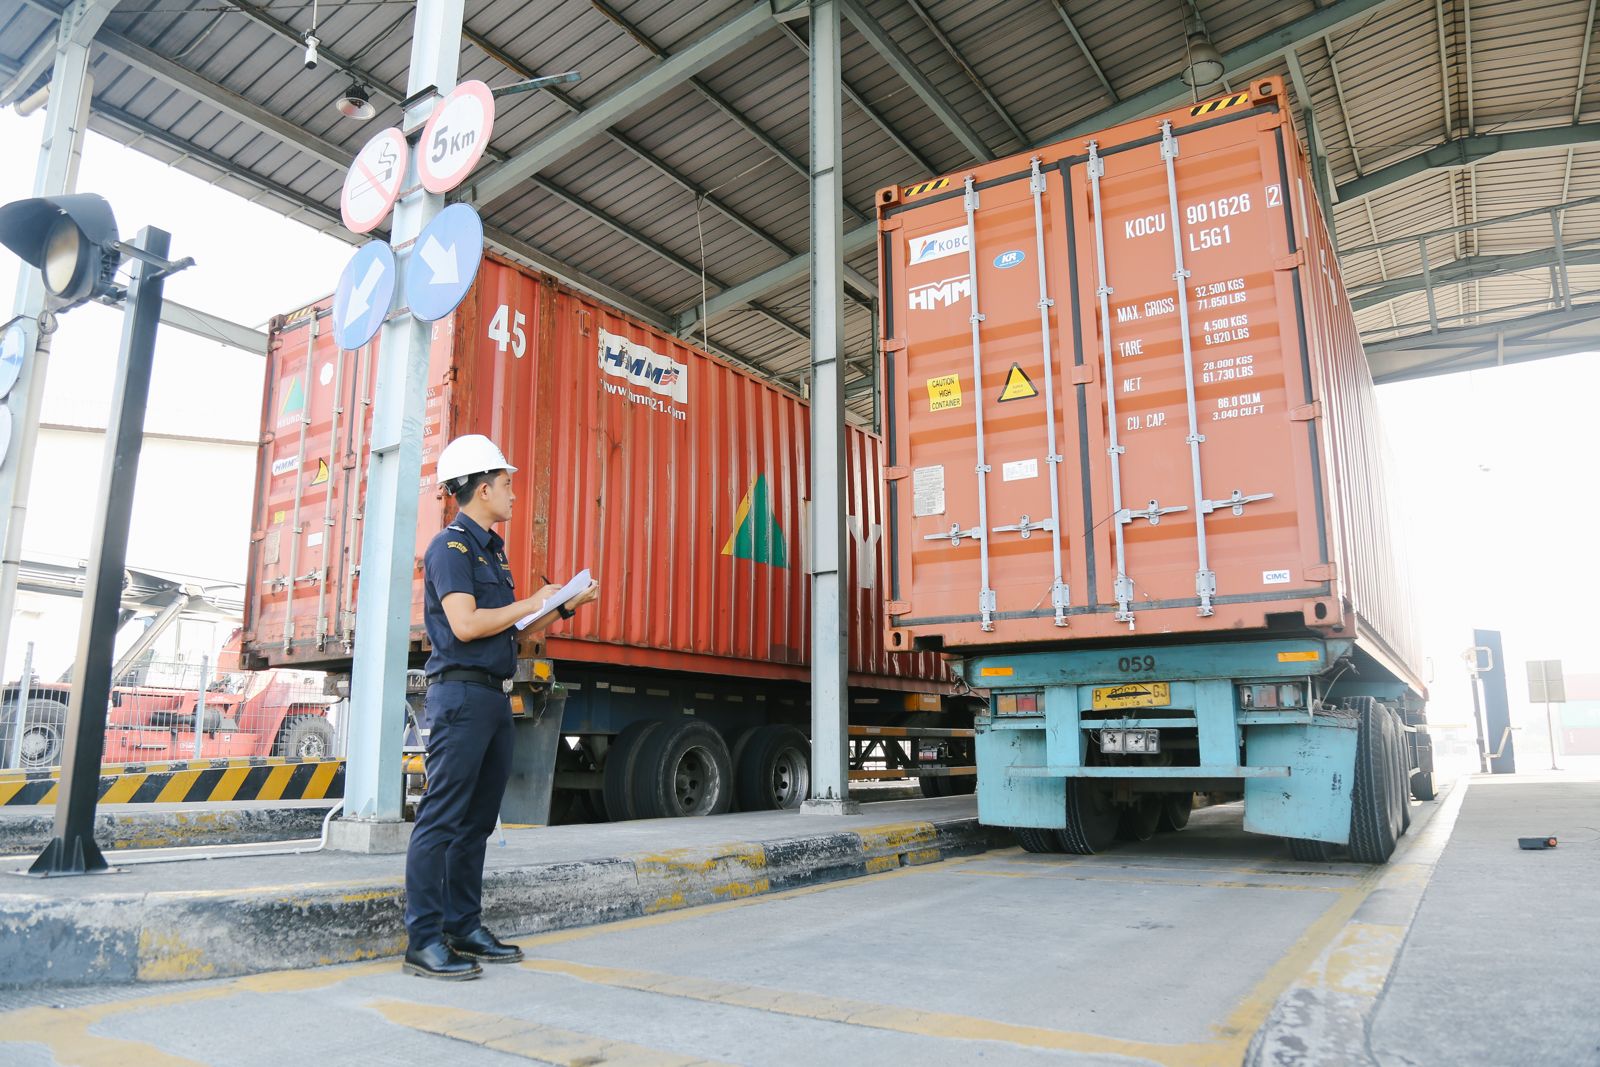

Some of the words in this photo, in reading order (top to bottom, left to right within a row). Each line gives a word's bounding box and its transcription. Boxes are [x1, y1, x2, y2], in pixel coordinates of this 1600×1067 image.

[431, 126, 449, 163] 5
[450, 128, 475, 155] Km
[1125, 213, 1166, 239] KOCU
[1186, 193, 1251, 225] 901626
[1267, 185, 1281, 207] 2
[1189, 224, 1231, 252] L5G1
[1001, 252, 1017, 264] KR
[908, 274, 971, 310] HMM
[1195, 282, 1226, 298] 32.500
[1226, 278, 1245, 291] KGS
[1117, 305, 1142, 323] MAX.
[1145, 297, 1175, 317] GROSS
[1197, 296, 1228, 311] 71.650
[1229, 291, 1246, 304] LBS
[487, 303, 527, 359] 45
[1203, 318, 1229, 332] 4.500
[1230, 314, 1248, 327] KGS
[1205, 331, 1231, 345] 9.920
[1232, 328, 1250, 341] LBS
[1119, 339, 1144, 358] TARE
[604, 346, 664, 385] HMM
[1203, 357, 1234, 371] 28.000
[1235, 355, 1253, 366] KGS
[932, 377, 955, 388] CAUTION
[1203, 369, 1235, 383] 61.730
[1236, 366, 1254, 378] LBS
[939, 389, 952, 398] HIGH
[1123, 377, 1142, 393] NET
[932, 398, 960, 410] CONTAINER
[1217, 396, 1238, 409] 86.0
[1127, 416, 1143, 431] CU.
[1146, 412, 1167, 428] CAP.
[1212, 408, 1238, 421] 3.040
[1265, 572, 1288, 581] CIMC
[1118, 655, 1156, 673] 059
[1094, 689, 1102, 702] B
[1152, 683, 1168, 698] GJ
